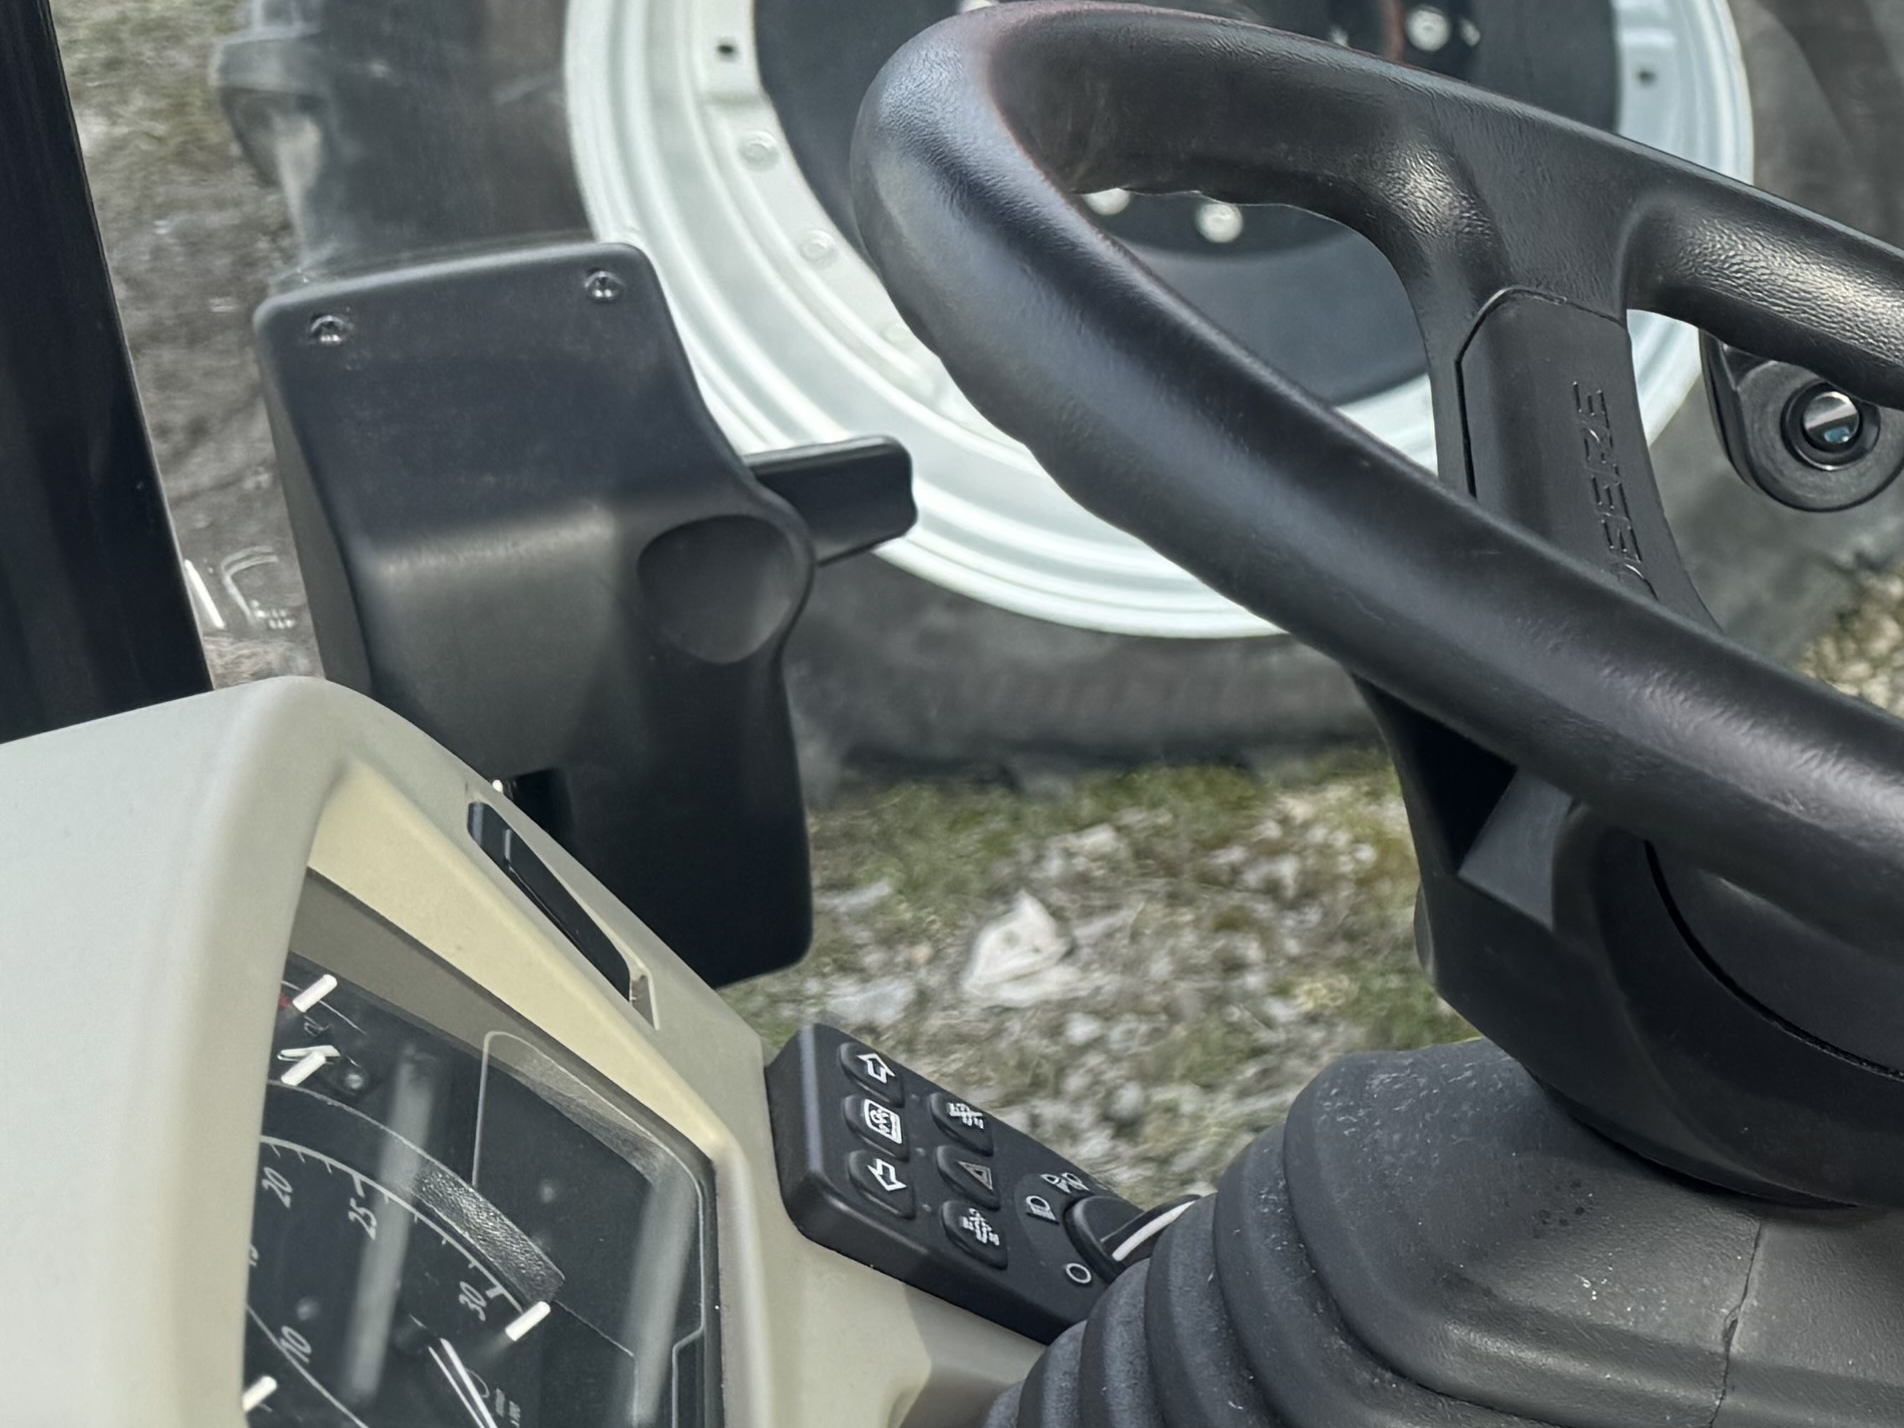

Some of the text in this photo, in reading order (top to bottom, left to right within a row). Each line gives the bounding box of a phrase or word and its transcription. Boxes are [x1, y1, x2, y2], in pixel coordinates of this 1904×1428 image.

[261, 1166, 294, 1209] 20
[348, 1197, 378, 1240] 25
[458, 1281, 490, 1322] 30
[280, 1326, 312, 1364] 10
